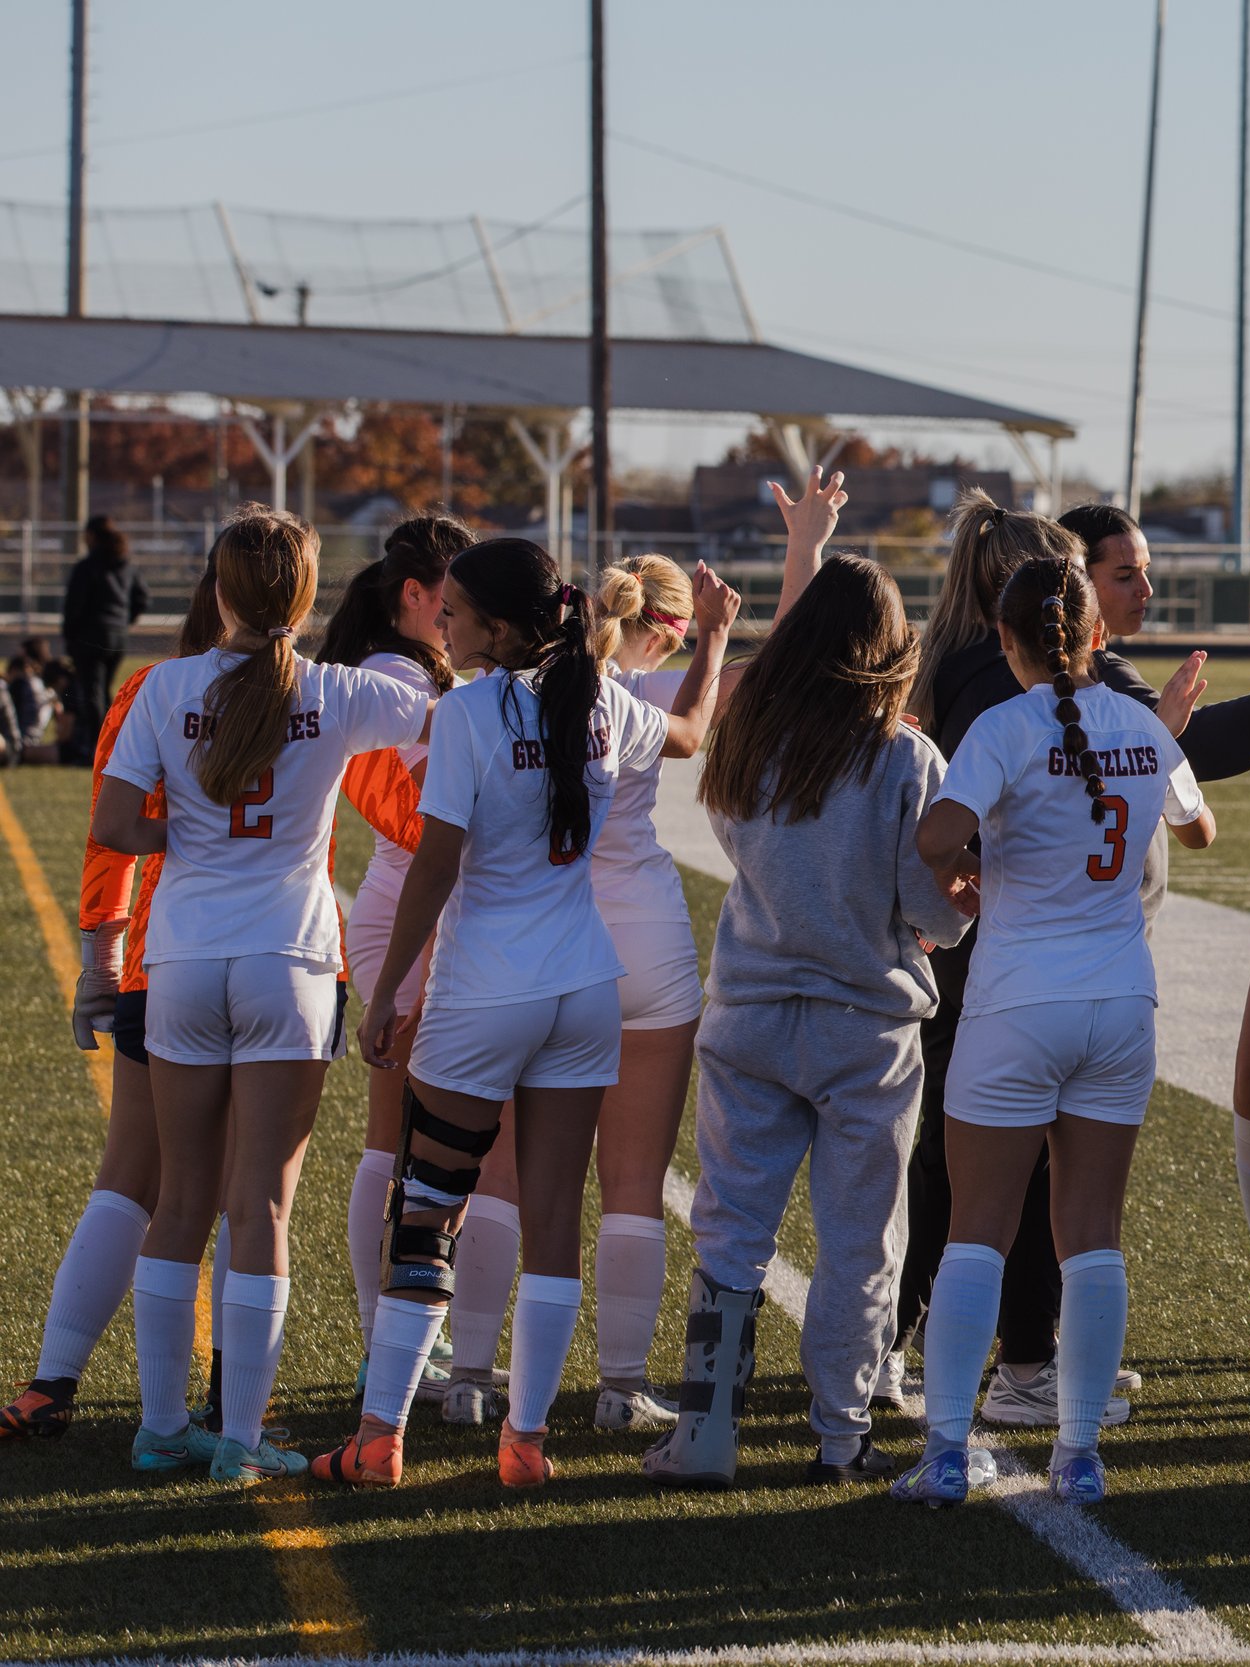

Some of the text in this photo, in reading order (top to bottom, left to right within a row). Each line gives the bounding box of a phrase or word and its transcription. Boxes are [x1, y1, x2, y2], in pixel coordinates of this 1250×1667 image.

[1048, 746, 1158, 777] GRZLIES
[229, 766, 273, 839] 2
[1086, 795, 1129, 881] 3
[409, 1270, 450, 1281] DONJO
